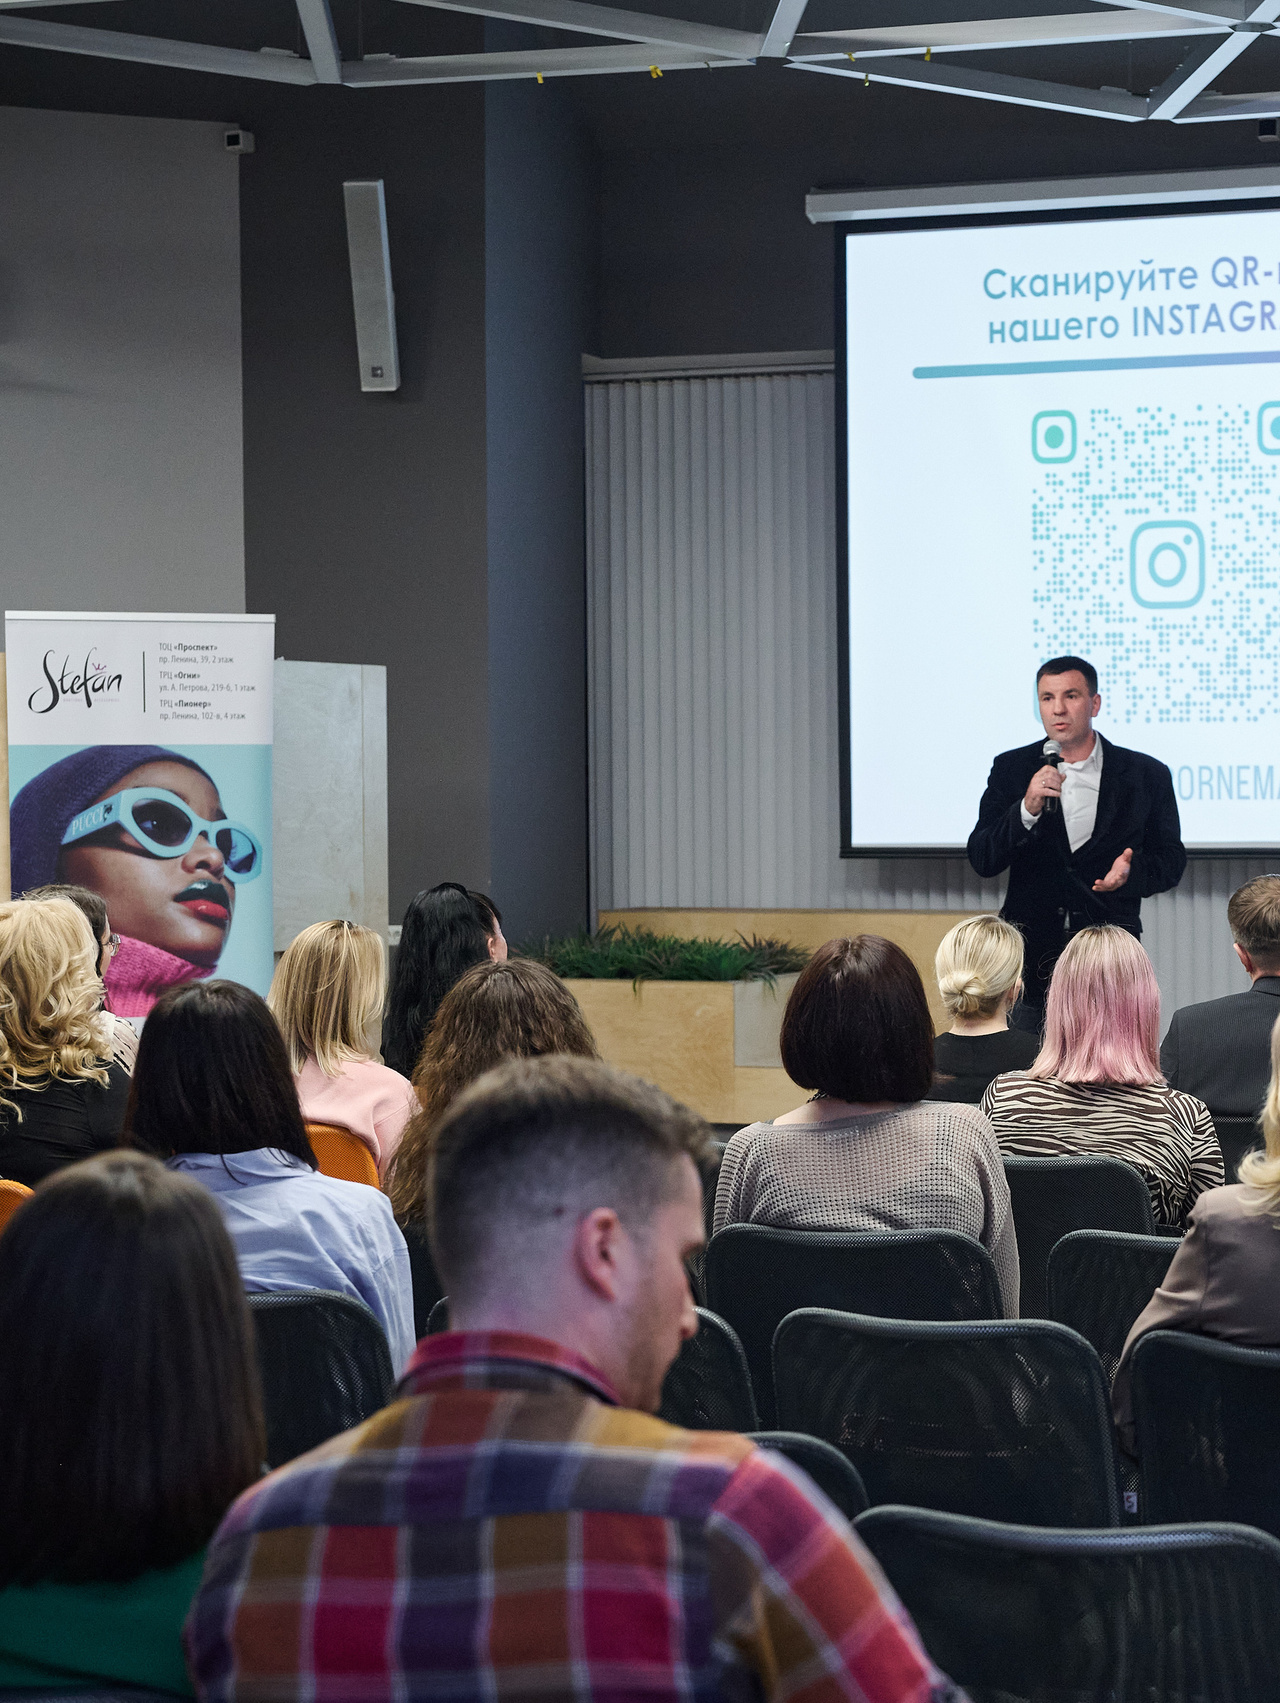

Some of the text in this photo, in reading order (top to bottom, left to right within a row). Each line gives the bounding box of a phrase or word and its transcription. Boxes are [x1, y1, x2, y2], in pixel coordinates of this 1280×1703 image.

[982, 259, 1199, 301] Сканируйте
[988, 314, 1120, 344] нашего
[159, 643, 218, 653] ТОЦ «Проспект»
[171, 656, 199, 664] Ленина,
[159, 671, 201, 680] ТРЦ «Огни»
[28, 647, 123, 714] Stefan
[159, 685, 169, 693] ул.
[179, 684, 210, 693] Петрова,
[160, 700, 211, 709] ТРЦ «Пионер»
[159, 713, 170, 721] пр.
[172, 712, 199, 721] Ленина,
[71, 806, 105, 836] PUCCI
